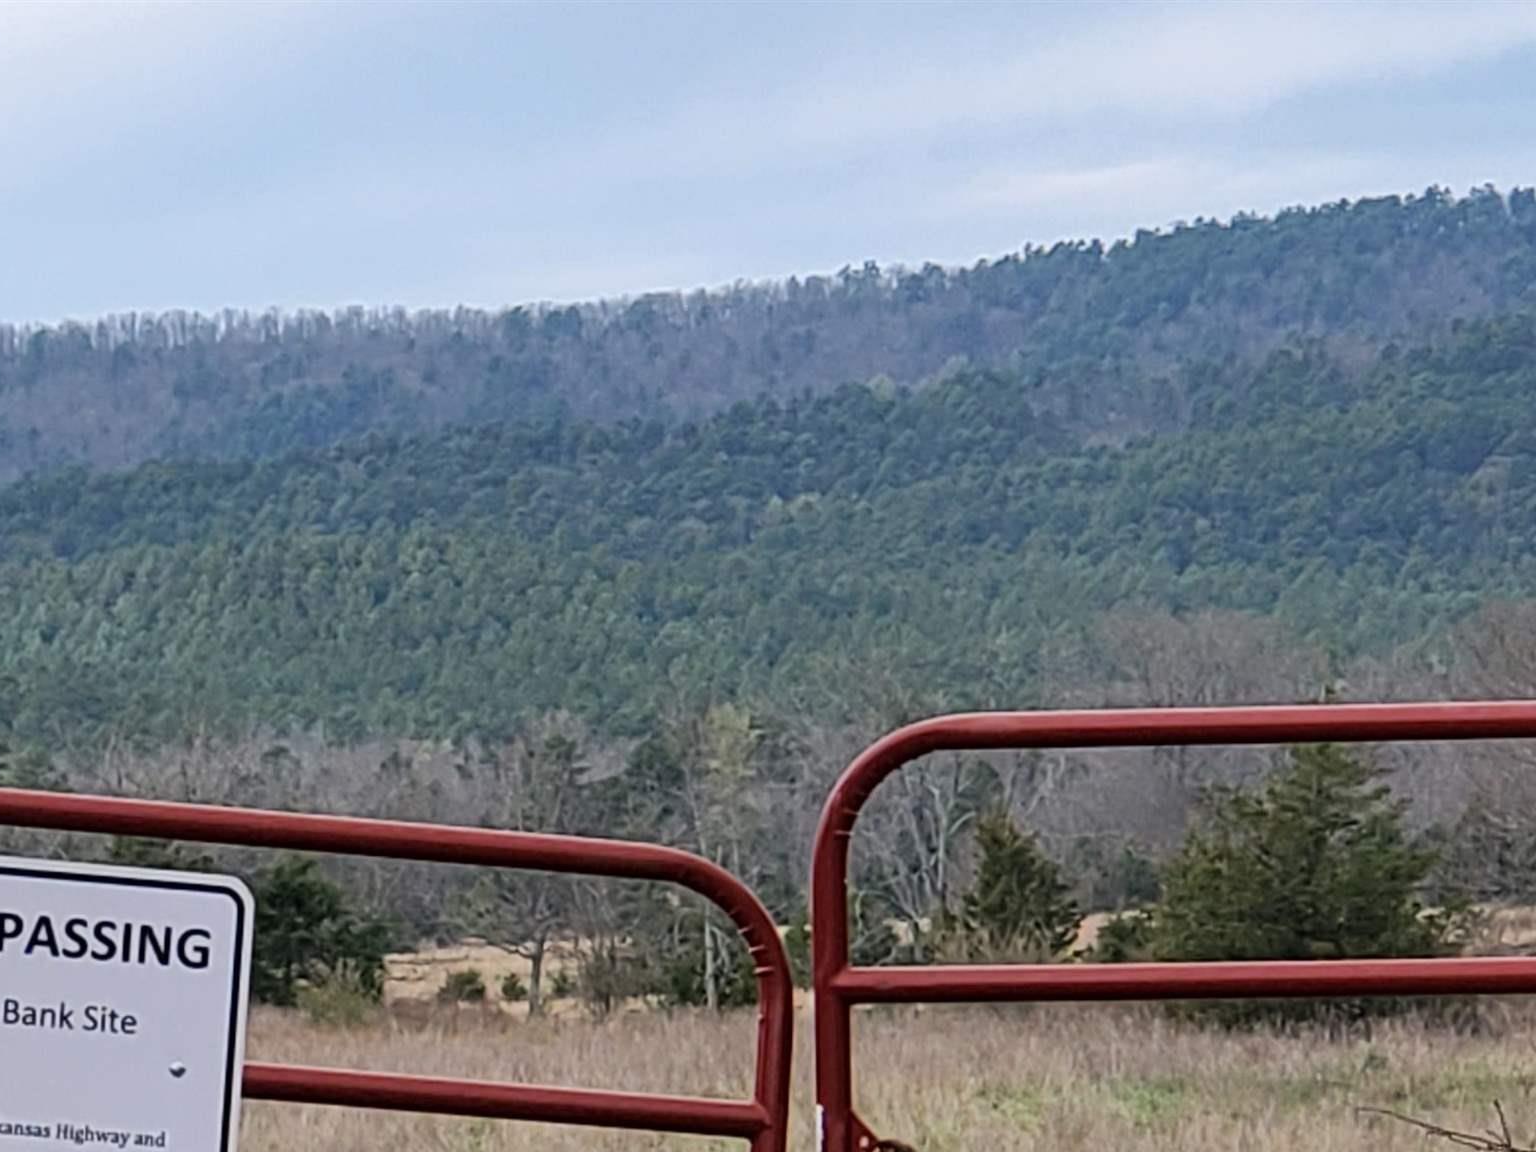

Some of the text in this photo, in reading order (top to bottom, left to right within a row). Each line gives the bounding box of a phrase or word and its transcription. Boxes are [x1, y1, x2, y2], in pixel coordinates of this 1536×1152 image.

[3, 998, 75, 1031] Bank
[82, 1005, 138, 1035] Site
[55, 1123, 130, 1148] Highway
[133, 1131, 167, 1148] and
